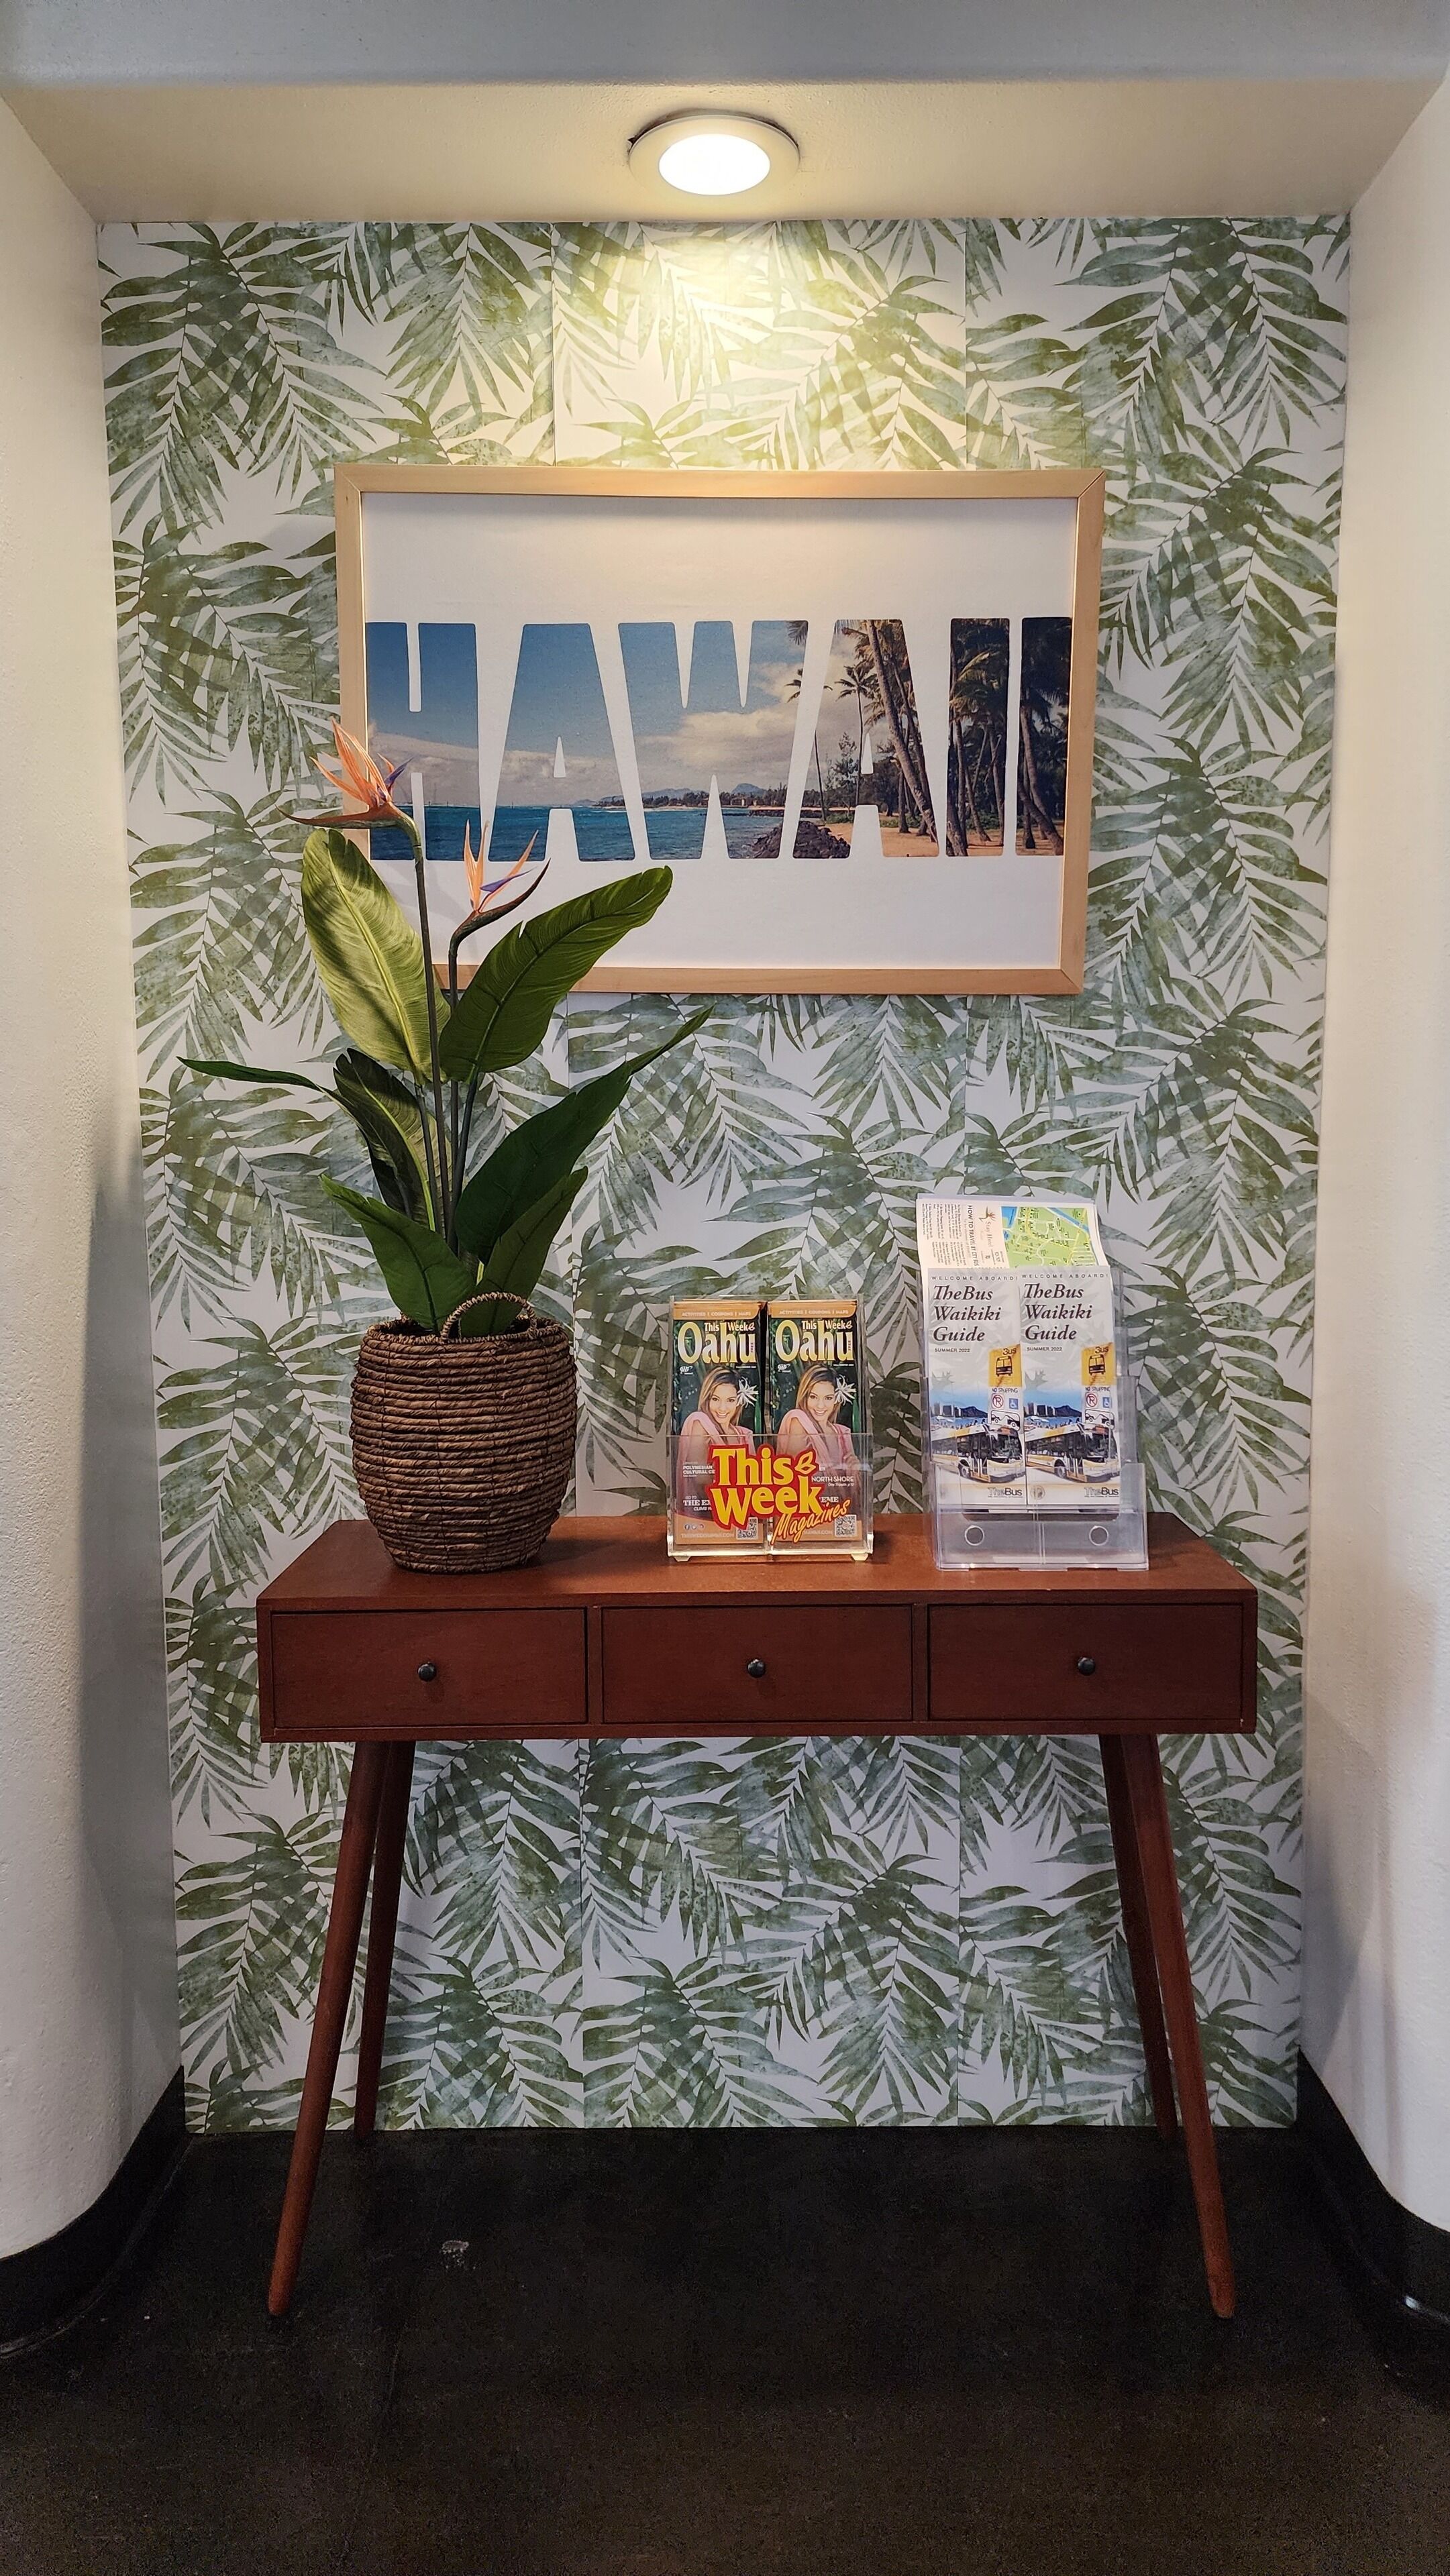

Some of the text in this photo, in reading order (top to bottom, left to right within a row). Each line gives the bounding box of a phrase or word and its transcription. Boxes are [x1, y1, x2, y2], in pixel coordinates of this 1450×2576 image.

[366, 617, 1072, 861] HAWAII
[933, 1285, 993, 1300] TheBus
[1024, 1283, 1084, 1299] TheBus
[934, 1305, 1002, 1321] Waikiki
[1025, 1303, 1092, 1320] Waikiki
[704, 1322, 749, 1332] This Week
[801, 1320, 846, 1330] This Week
[1025, 1324, 1077, 1340] Guide
[775, 1320, 854, 1362] Oahu
[933, 1326, 985, 1342] Guide
[678, 1322, 757, 1364] Oahu
[711, 1447, 794, 1485] This
[710, 1474, 824, 1526] Week
[770, 1499, 851, 1545] Magazines
